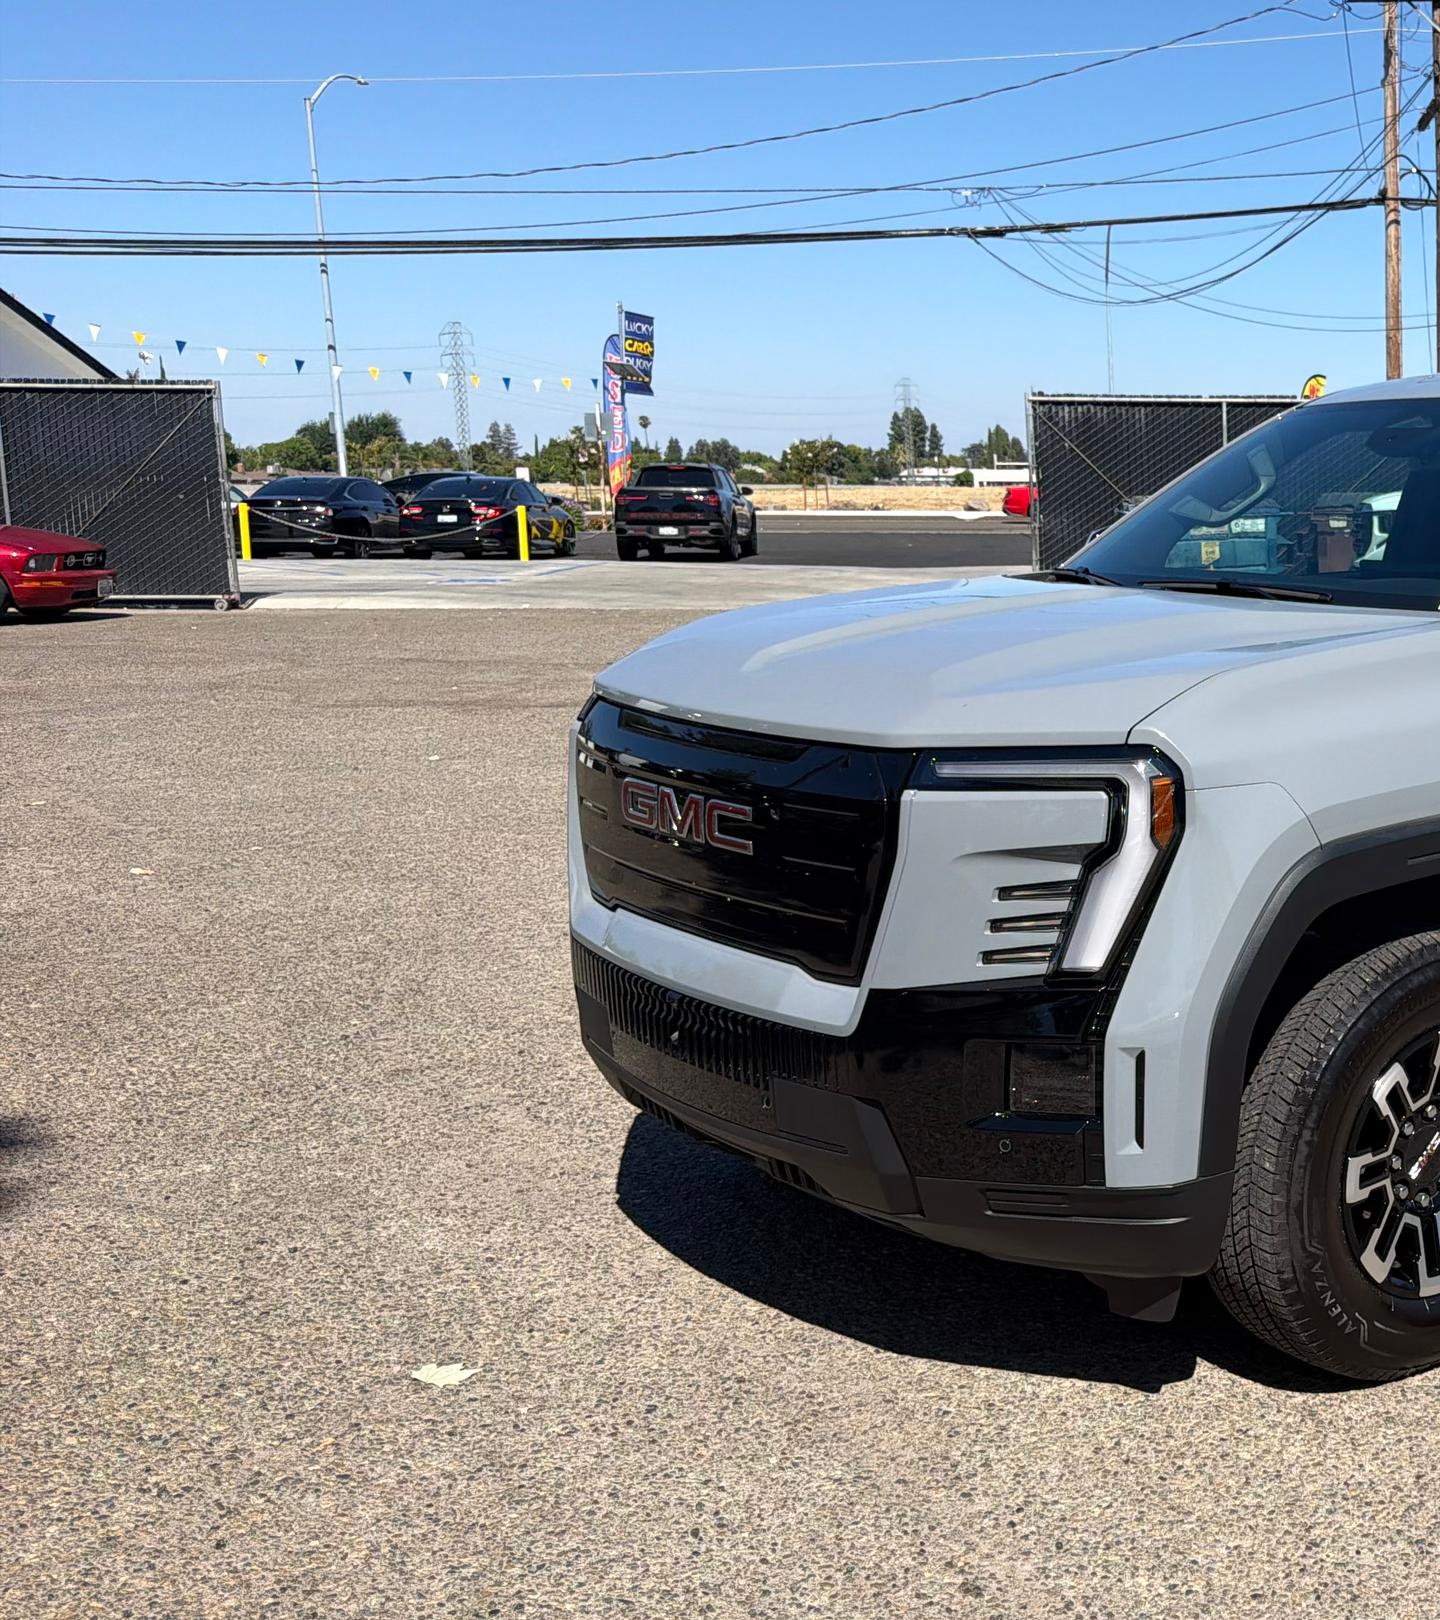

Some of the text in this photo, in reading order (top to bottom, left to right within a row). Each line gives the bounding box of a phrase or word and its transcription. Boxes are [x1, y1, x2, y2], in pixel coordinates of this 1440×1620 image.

[625, 320, 653, 336] LUCKY
[621, 776, 754, 856] GMC
[1311, 1260, 1357, 1334] ALENZA
